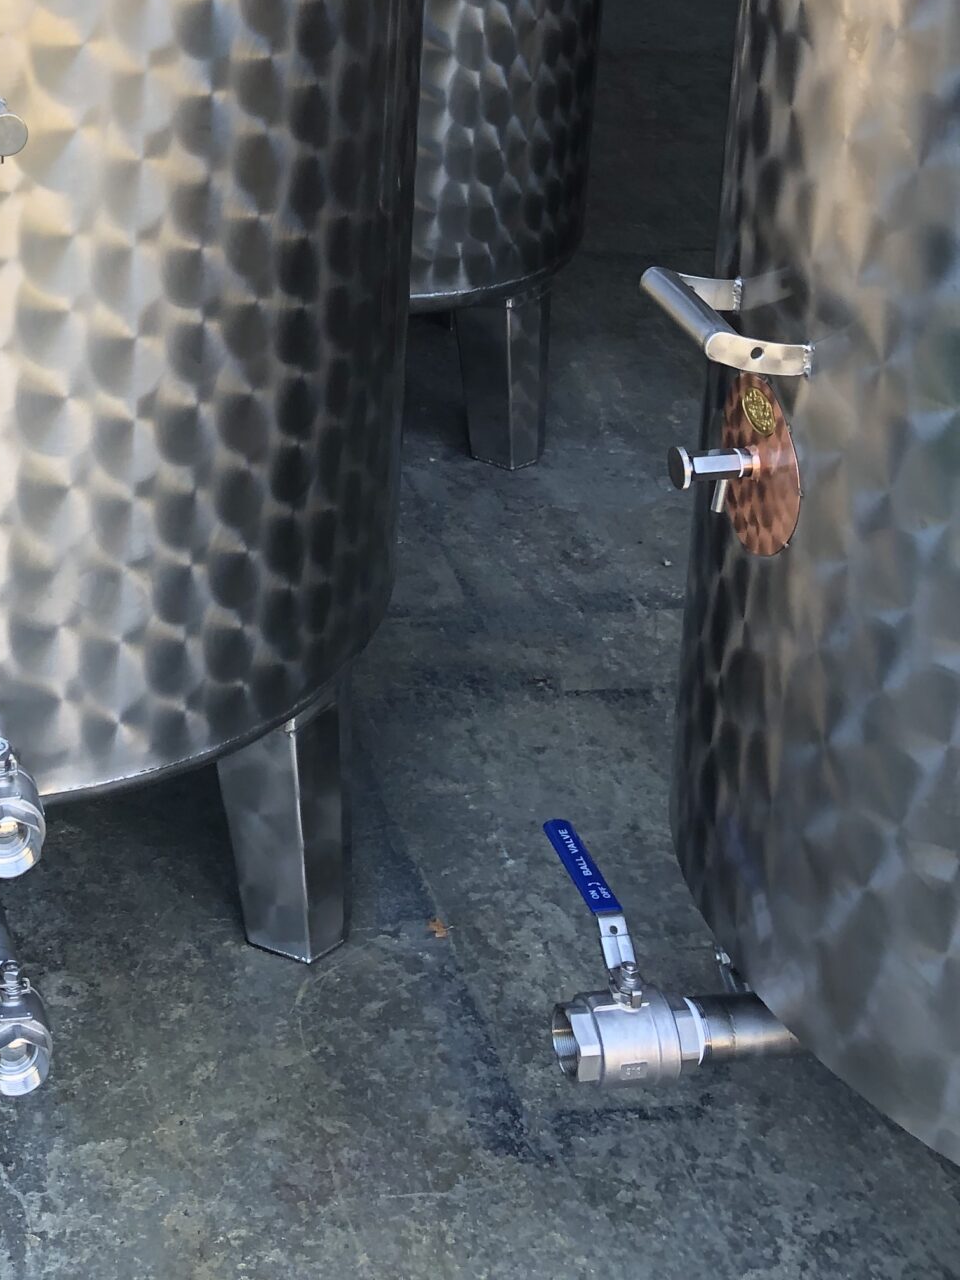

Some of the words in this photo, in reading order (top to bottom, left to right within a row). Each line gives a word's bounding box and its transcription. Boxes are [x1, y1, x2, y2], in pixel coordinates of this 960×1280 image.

[558, 828, 579, 854] VALVE
[575, 856, 593, 877] BALL
[589, 889, 600, 900] ON
[597, 886, 611, 899] OFF
